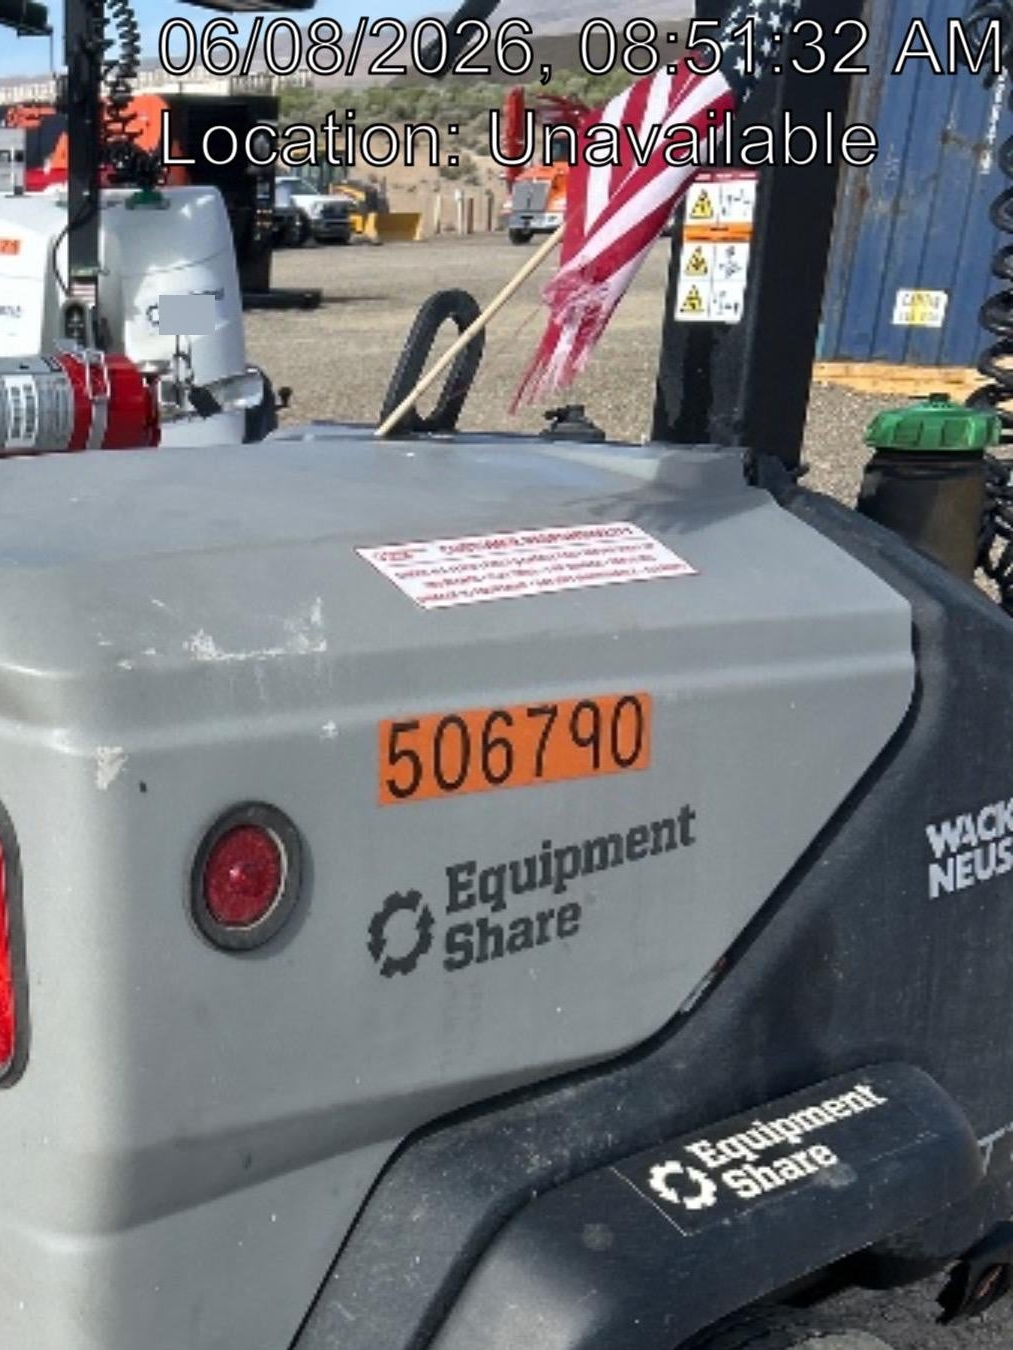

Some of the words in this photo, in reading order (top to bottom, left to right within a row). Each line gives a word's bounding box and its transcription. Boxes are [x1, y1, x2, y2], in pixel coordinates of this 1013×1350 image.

[386, 695, 643, 798] 506790
[445, 804, 696, 914] Equipment
[443, 902, 582, 972] Share
[685, 1081, 888, 1170] Equipment
[721, 1143, 838, 1199] Share
